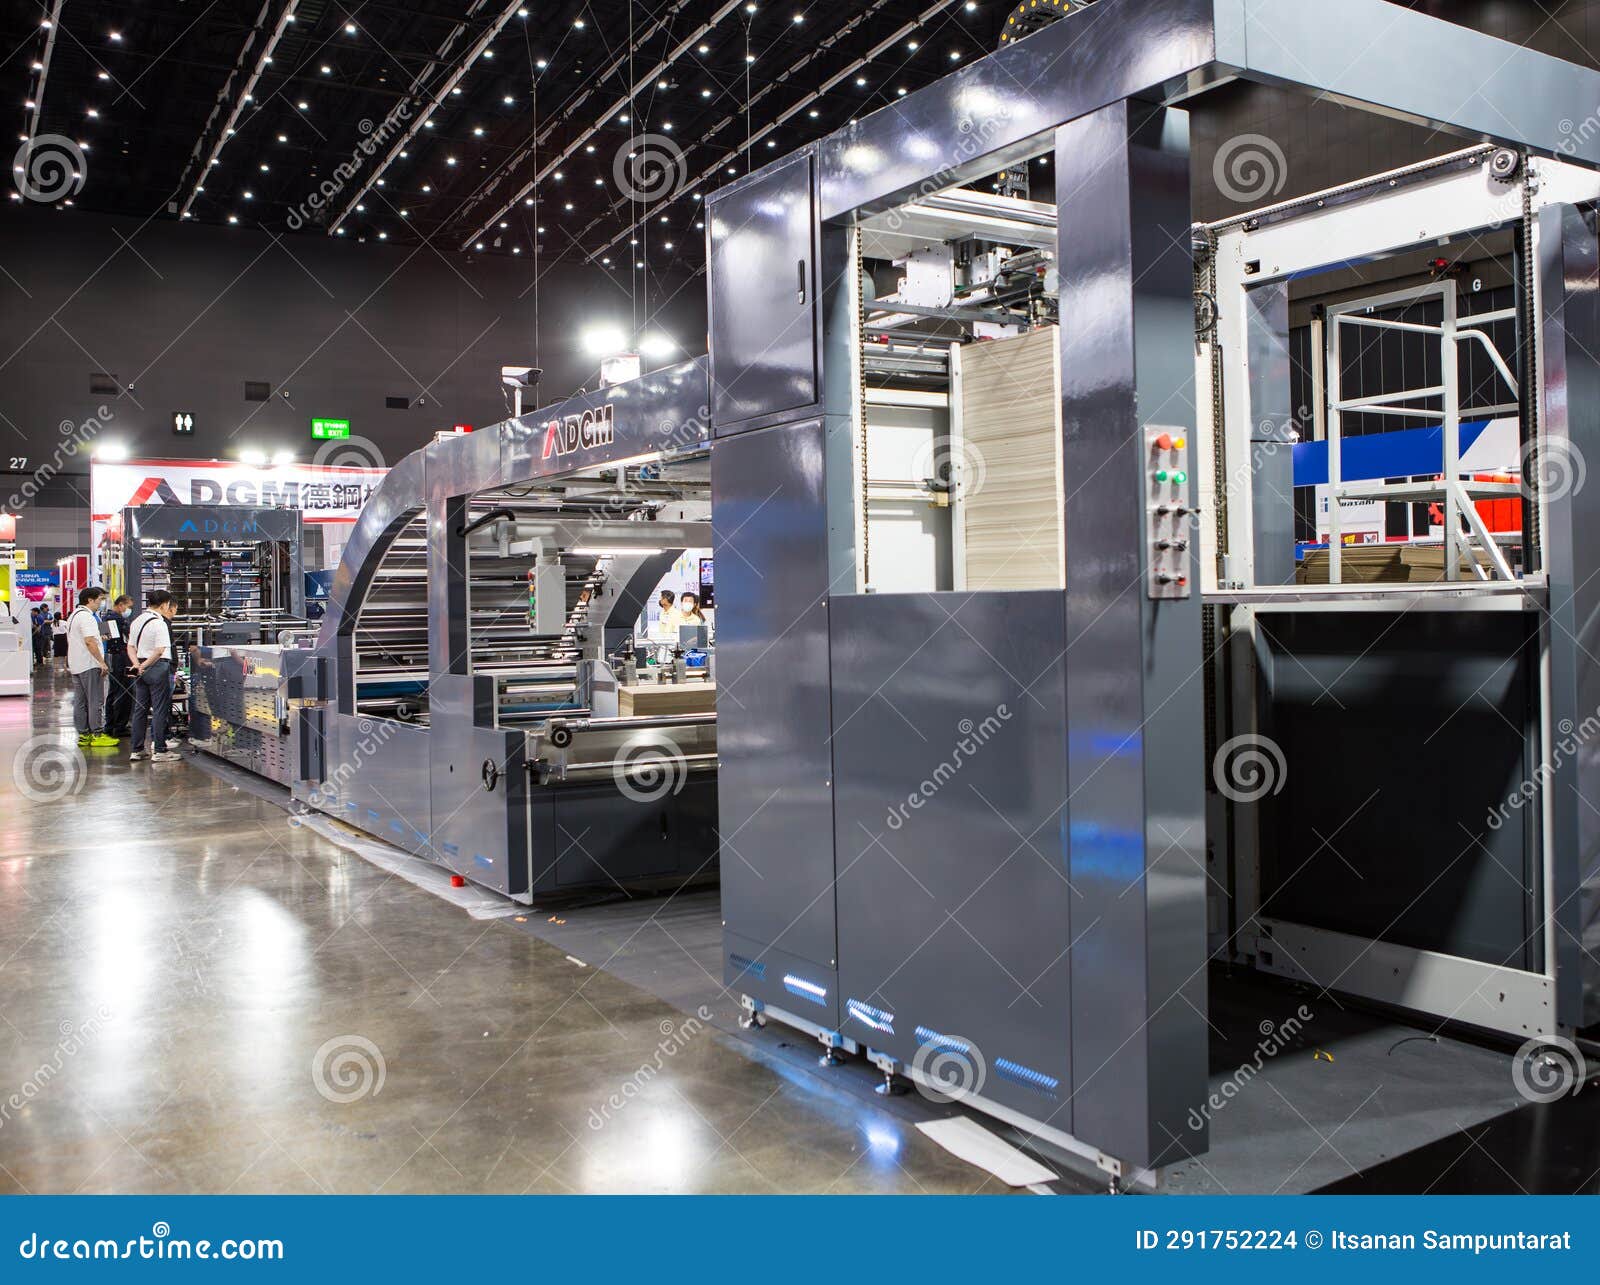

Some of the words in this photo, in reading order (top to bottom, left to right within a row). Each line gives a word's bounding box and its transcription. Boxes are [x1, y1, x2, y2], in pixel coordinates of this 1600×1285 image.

[1473, 279, 1481, 291] G
[328, 429, 343, 437] EXIT
[542, 404, 614, 459] ADGM
[10, 457, 27, 469] 27
